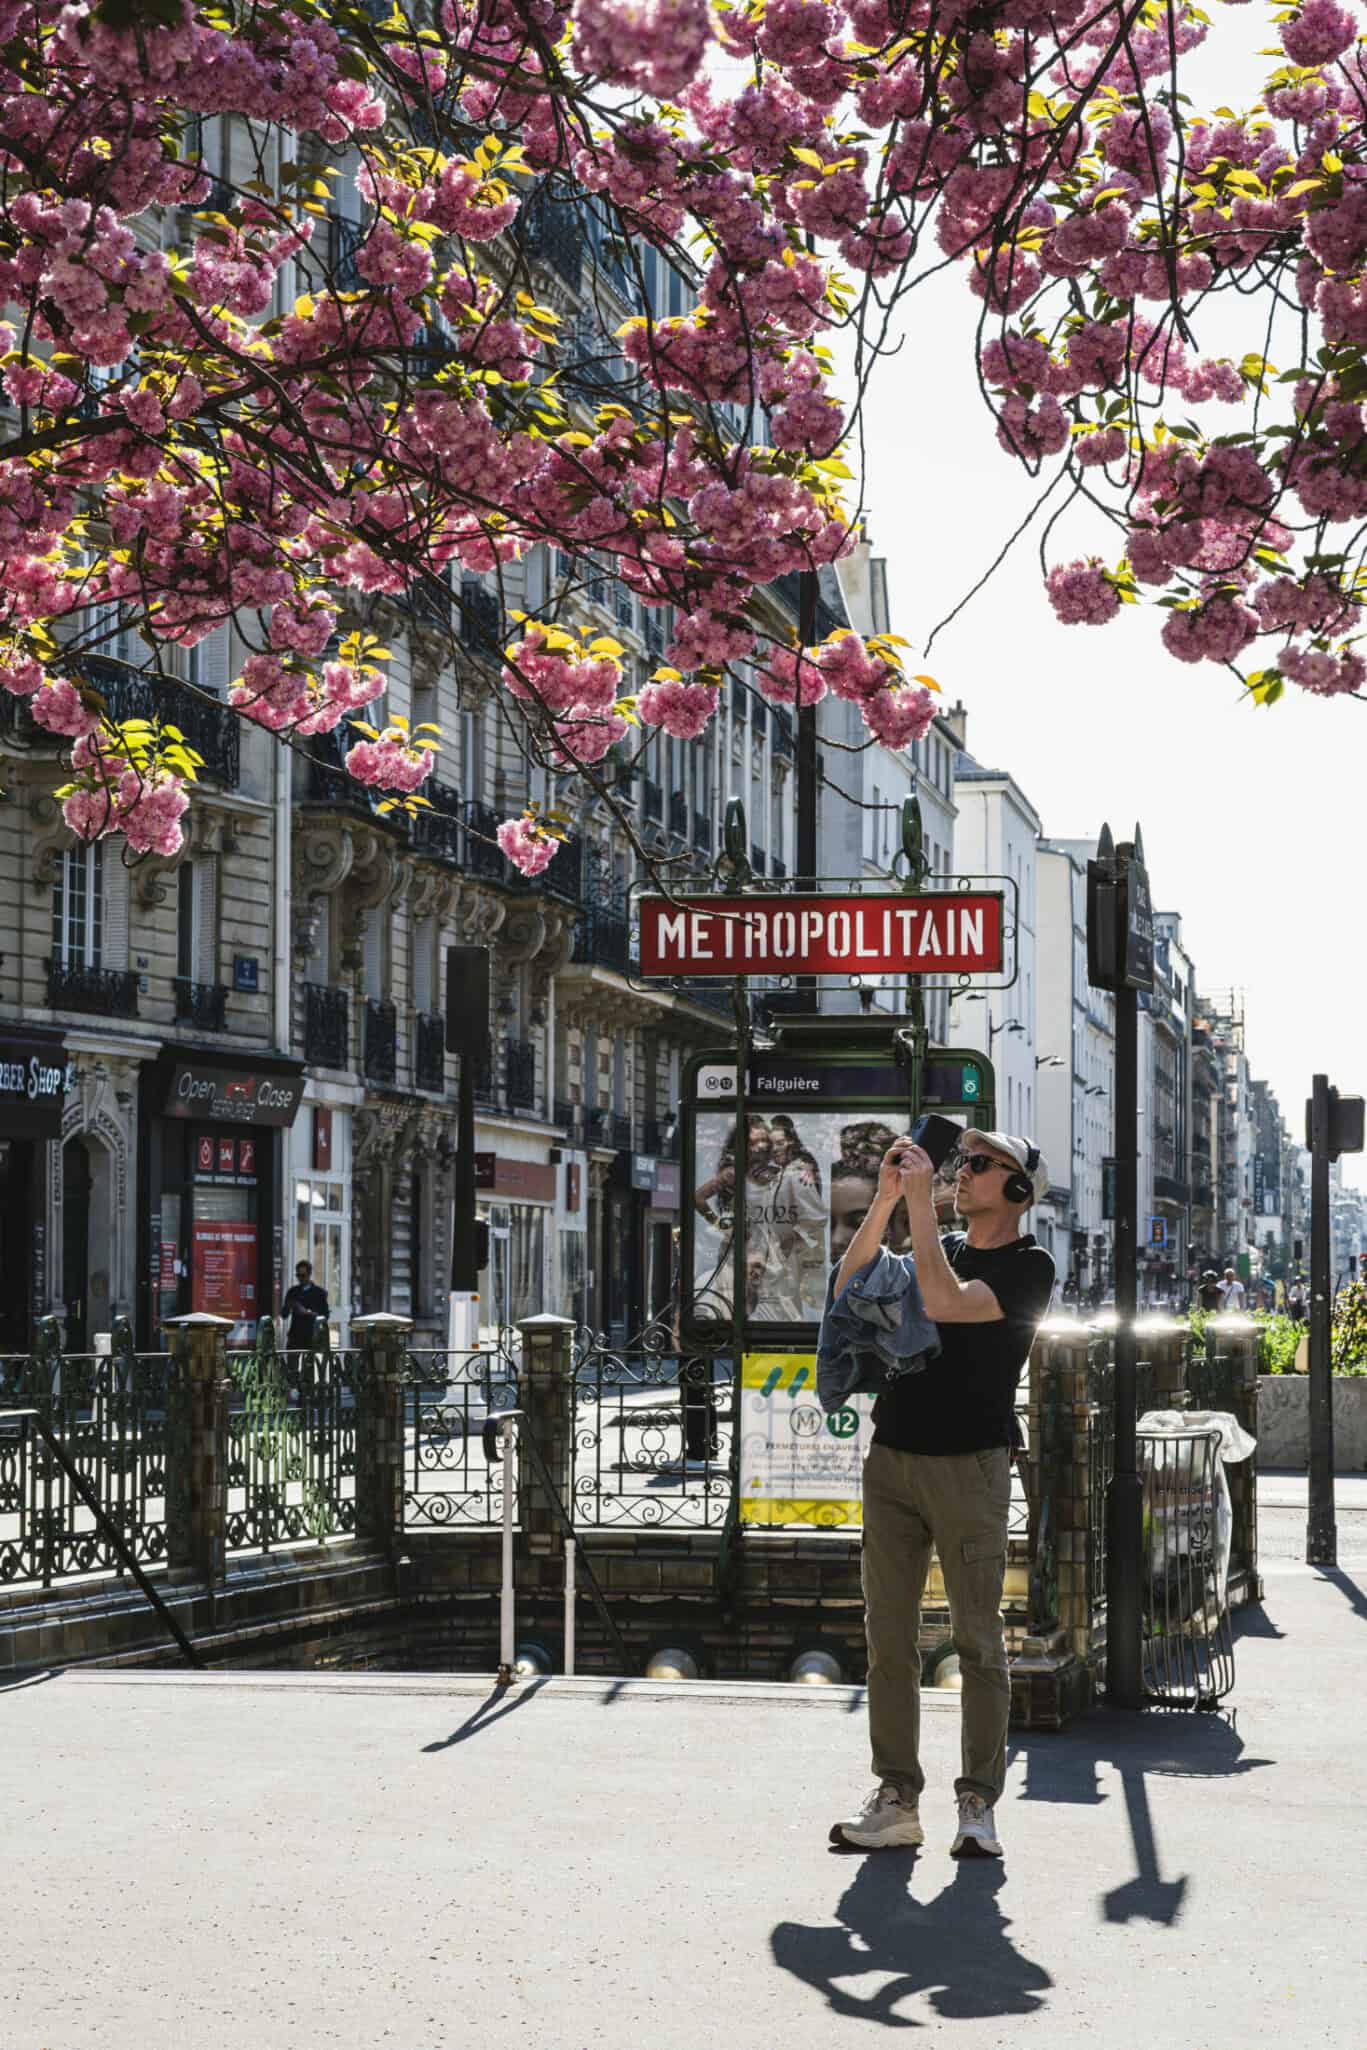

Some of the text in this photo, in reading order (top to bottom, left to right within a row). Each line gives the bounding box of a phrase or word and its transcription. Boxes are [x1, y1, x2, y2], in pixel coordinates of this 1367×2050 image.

[657, 908, 985, 959] METROPOLITAIN
[178, 1071, 294, 1107] Open Close
[757, 1076, 820, 1093] Falguière
[752, 1206, 799, 1225] 2025
[830, 1411, 855, 1433] 12
